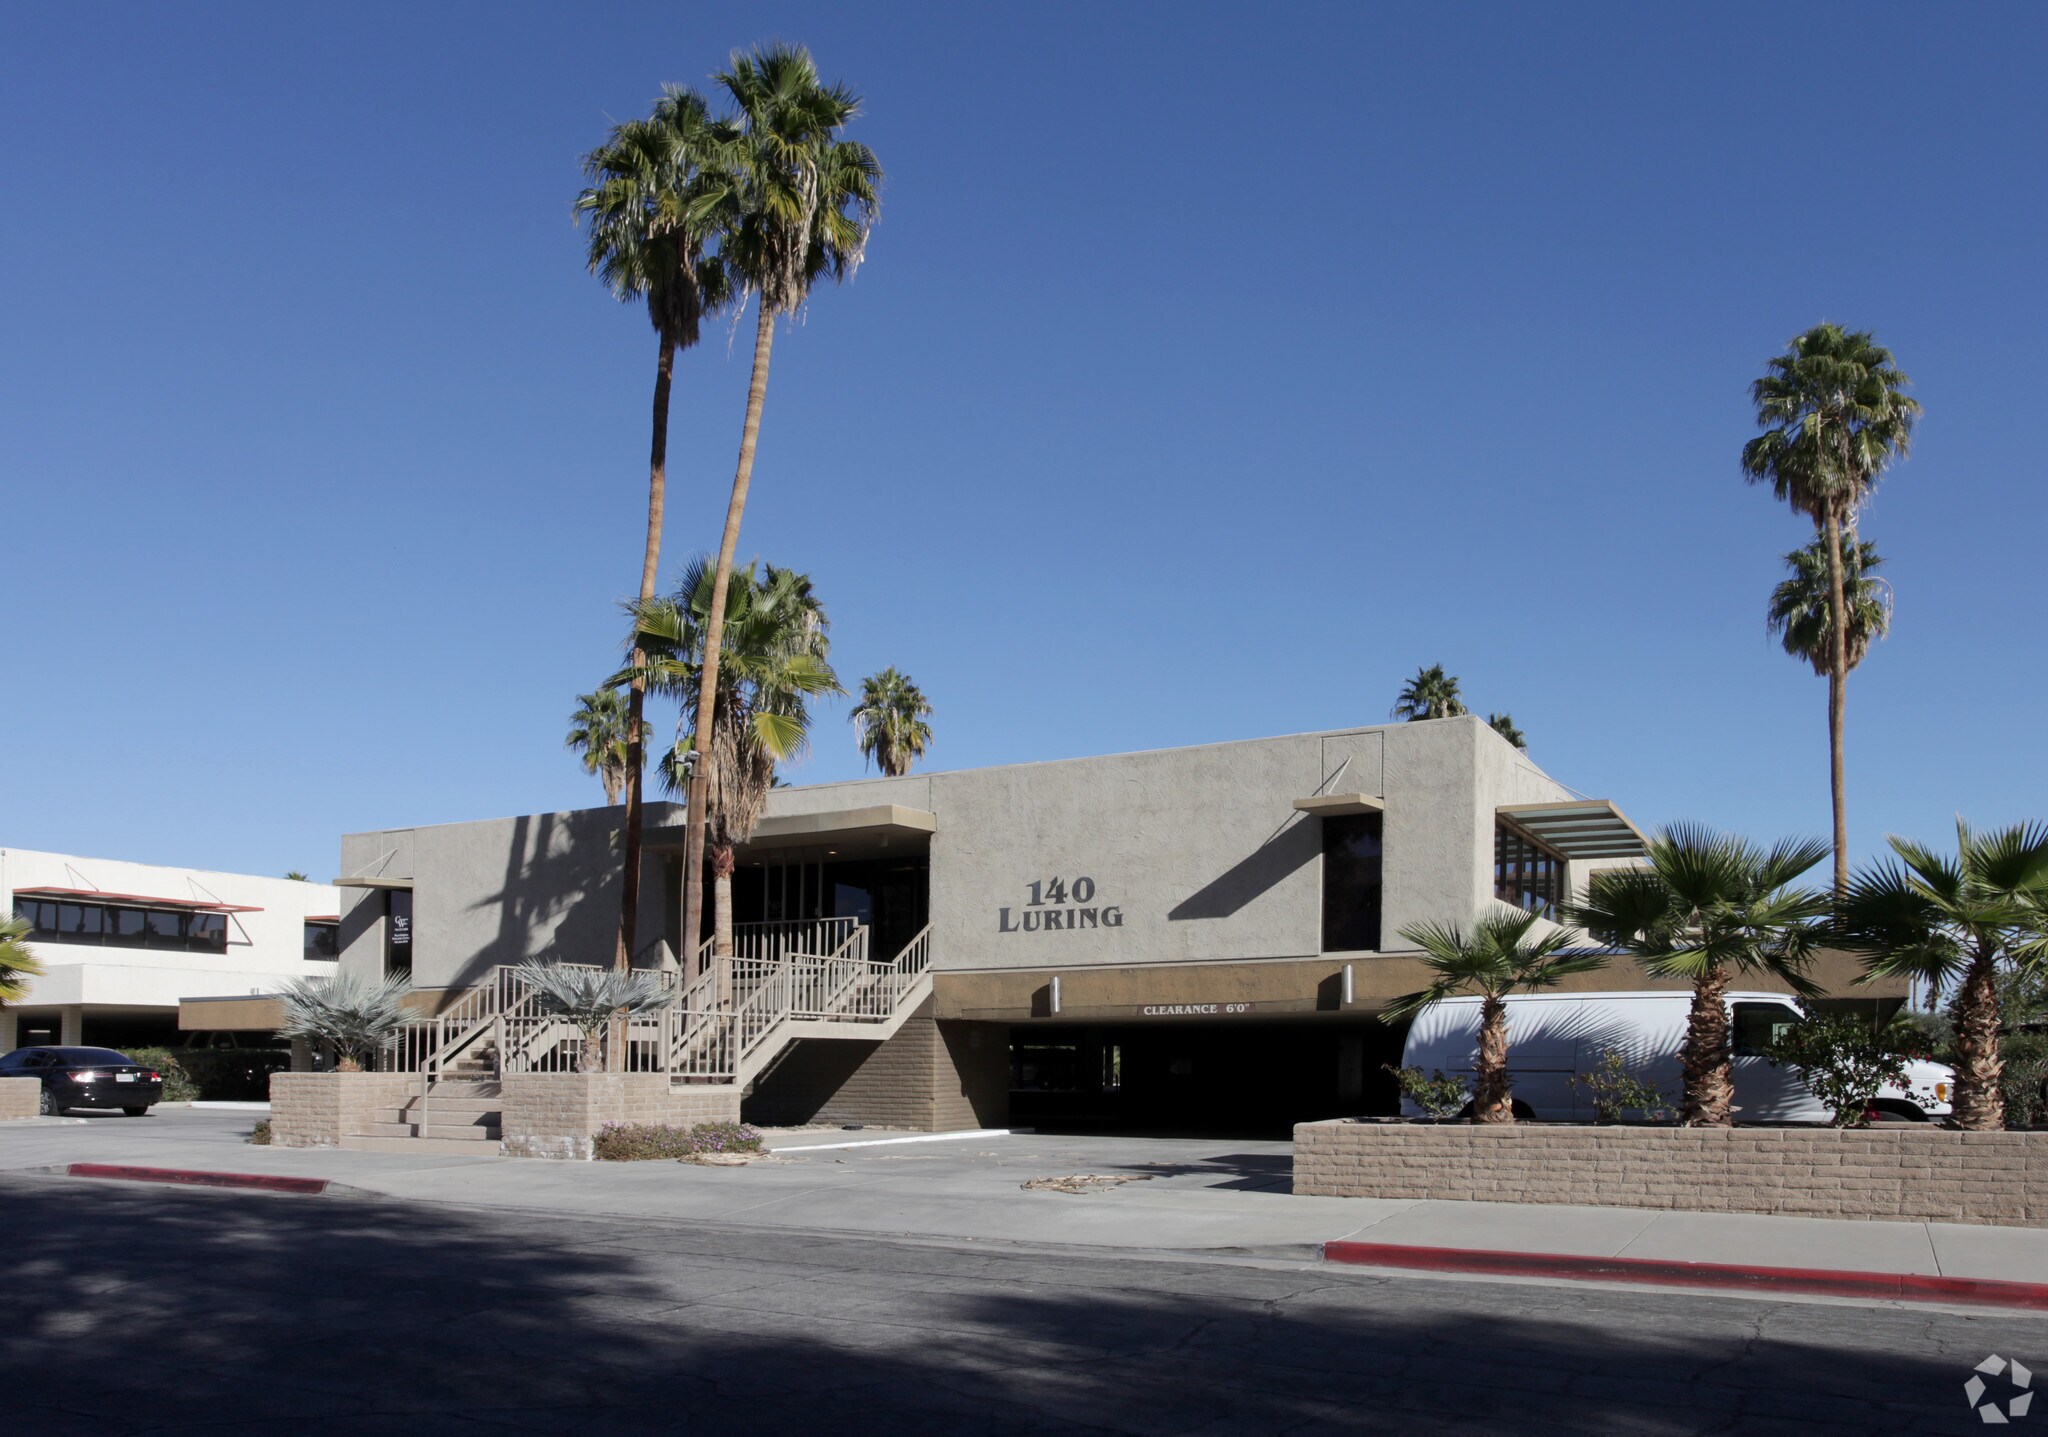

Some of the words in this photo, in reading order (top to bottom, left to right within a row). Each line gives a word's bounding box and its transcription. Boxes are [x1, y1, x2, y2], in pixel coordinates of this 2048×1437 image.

[1026, 876, 1096, 906] 140
[998, 905, 1124, 933] LURING
[1143, 1004, 1218, 1015] CLEARANCE
